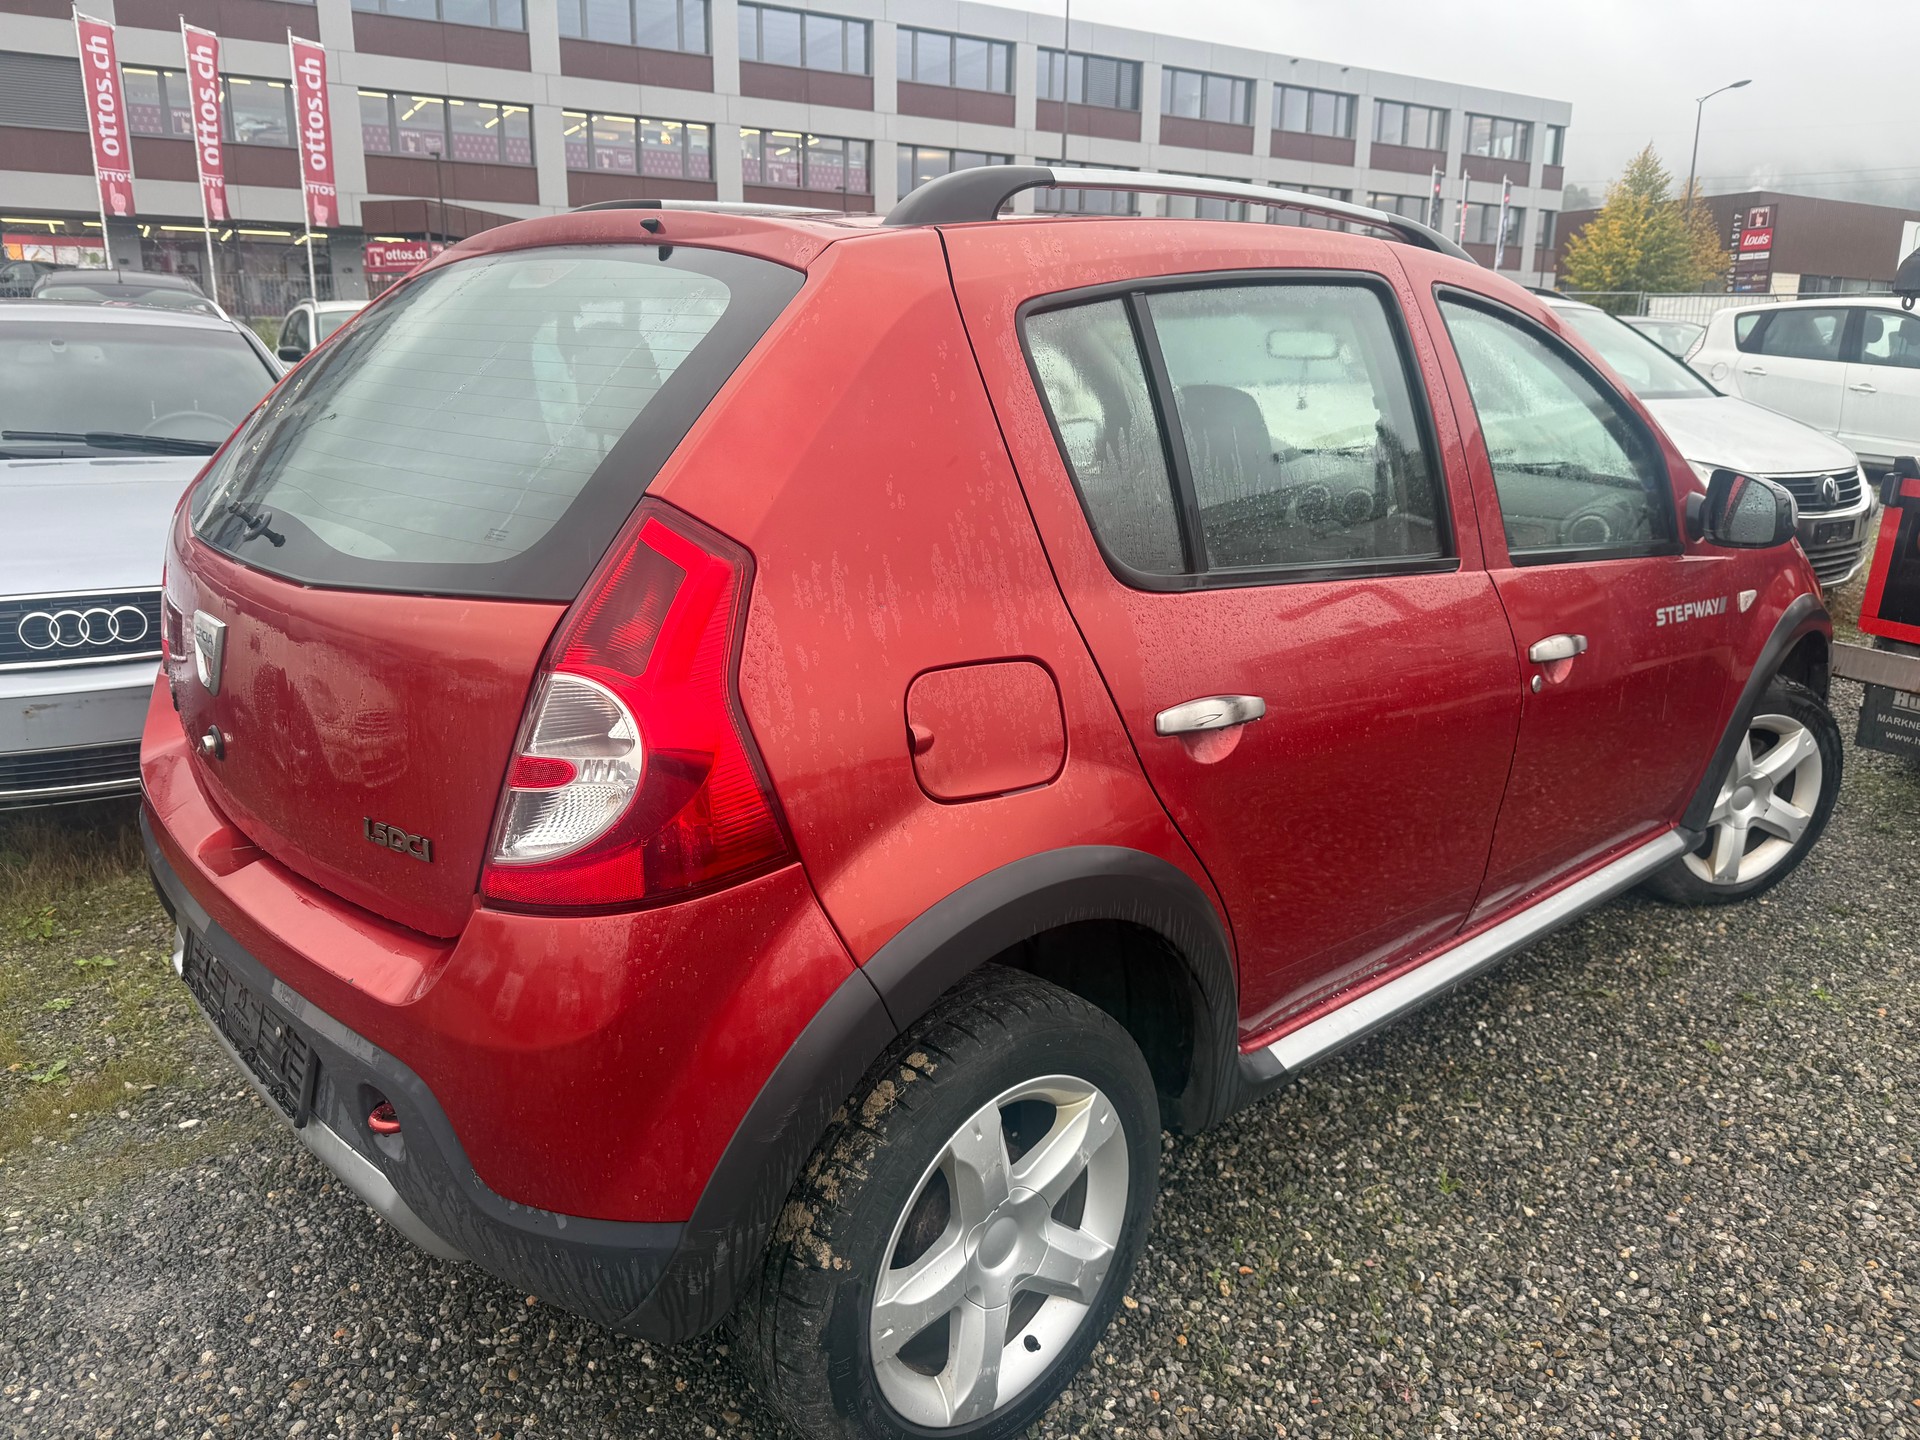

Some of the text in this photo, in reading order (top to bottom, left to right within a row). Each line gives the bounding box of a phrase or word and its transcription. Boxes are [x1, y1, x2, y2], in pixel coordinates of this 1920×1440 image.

[86, 35, 120, 156] ottos.ch
[190, 45, 220, 166] ottos.ch
[299, 57, 327, 171] ottos.ch
[1731, 213, 1742, 247] 15/17
[1743, 233, 1770, 246] Louis
[385, 247, 427, 260] ottos.ch
[1656, 598, 1719, 627] STEPWAY
